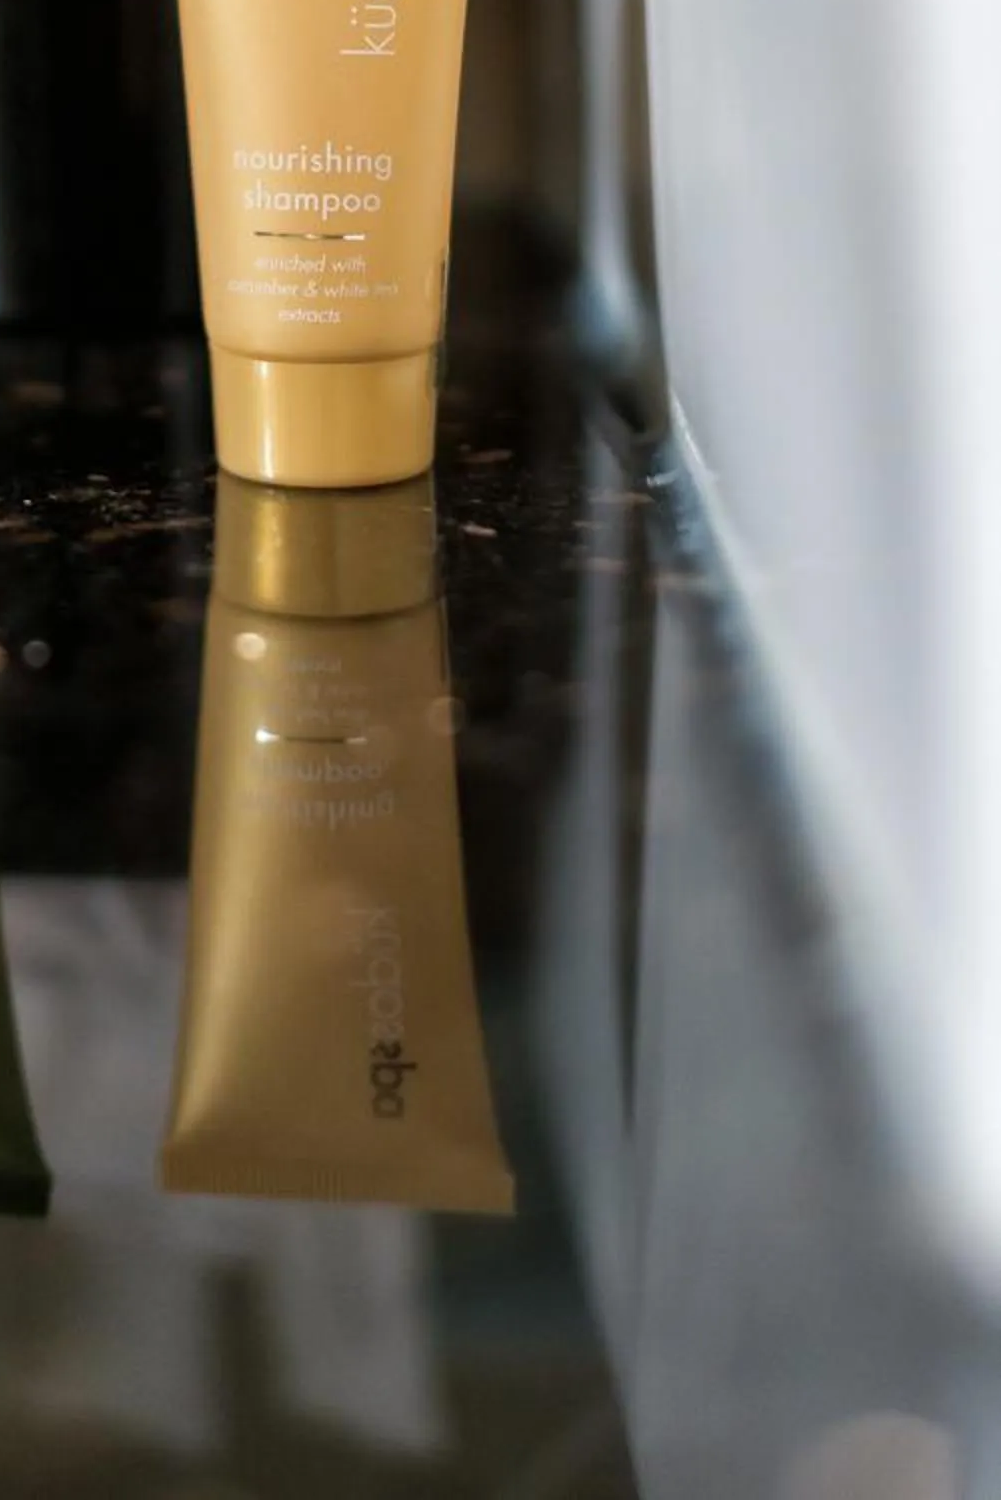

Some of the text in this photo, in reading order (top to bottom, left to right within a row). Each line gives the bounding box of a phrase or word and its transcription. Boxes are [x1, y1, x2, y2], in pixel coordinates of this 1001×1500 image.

[233, 140, 393, 182] nourishing
[243, 178, 382, 221] shampoo
[332, 254, 367, 276] with
